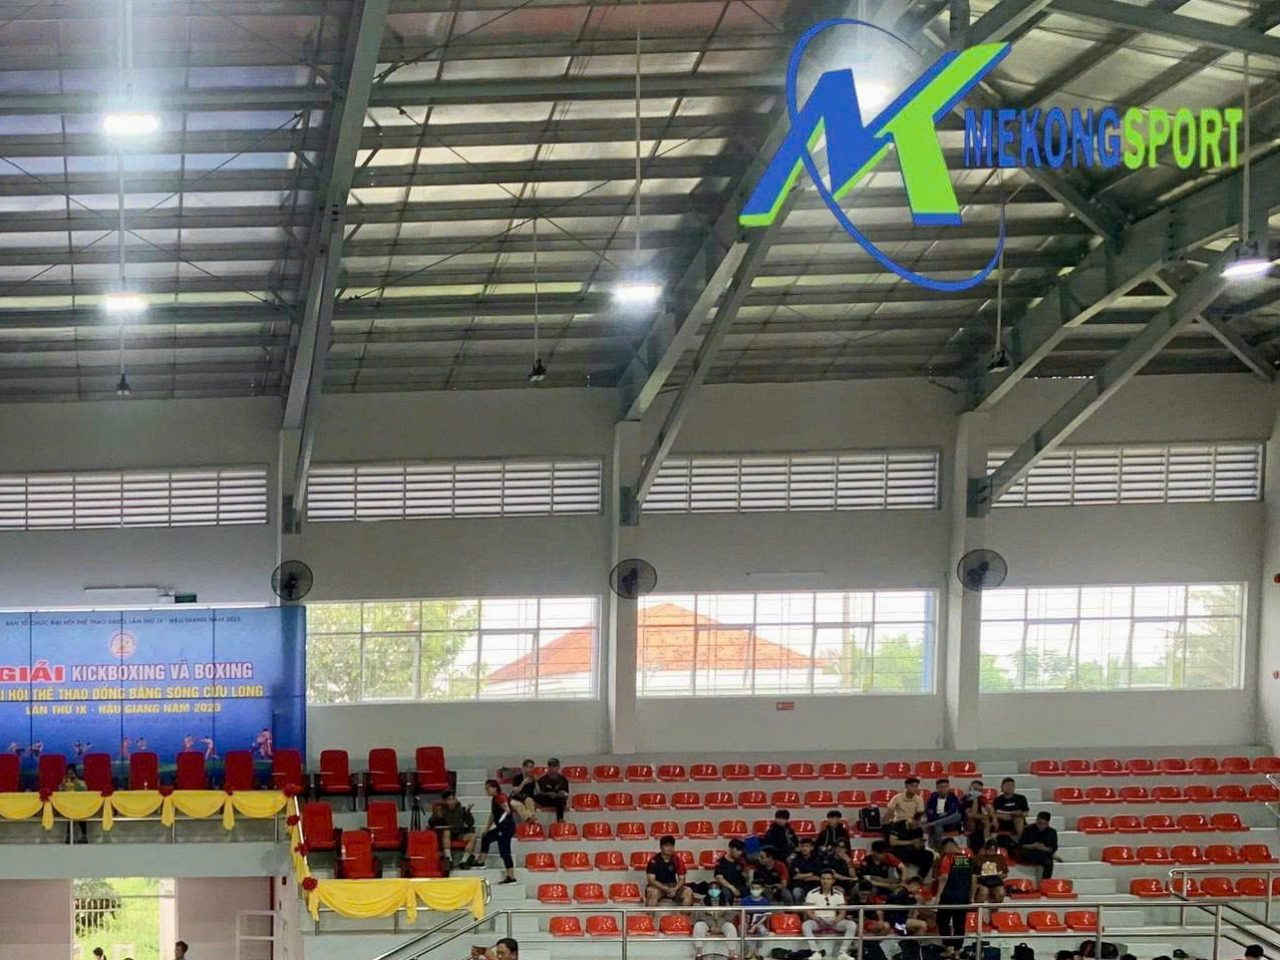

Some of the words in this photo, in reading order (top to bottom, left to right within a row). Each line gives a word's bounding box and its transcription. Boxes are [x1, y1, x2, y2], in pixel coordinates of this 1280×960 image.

[72, 664, 165, 682] KICKBOXING
[169, 660, 190, 680] VÀ
[194, 663, 253, 679] BOXING
[59, 688, 89, 700] THAO
[231, 685, 264, 697] LONG
[125, 703, 160, 714] GIANG
[194, 702, 222, 712] 2023
